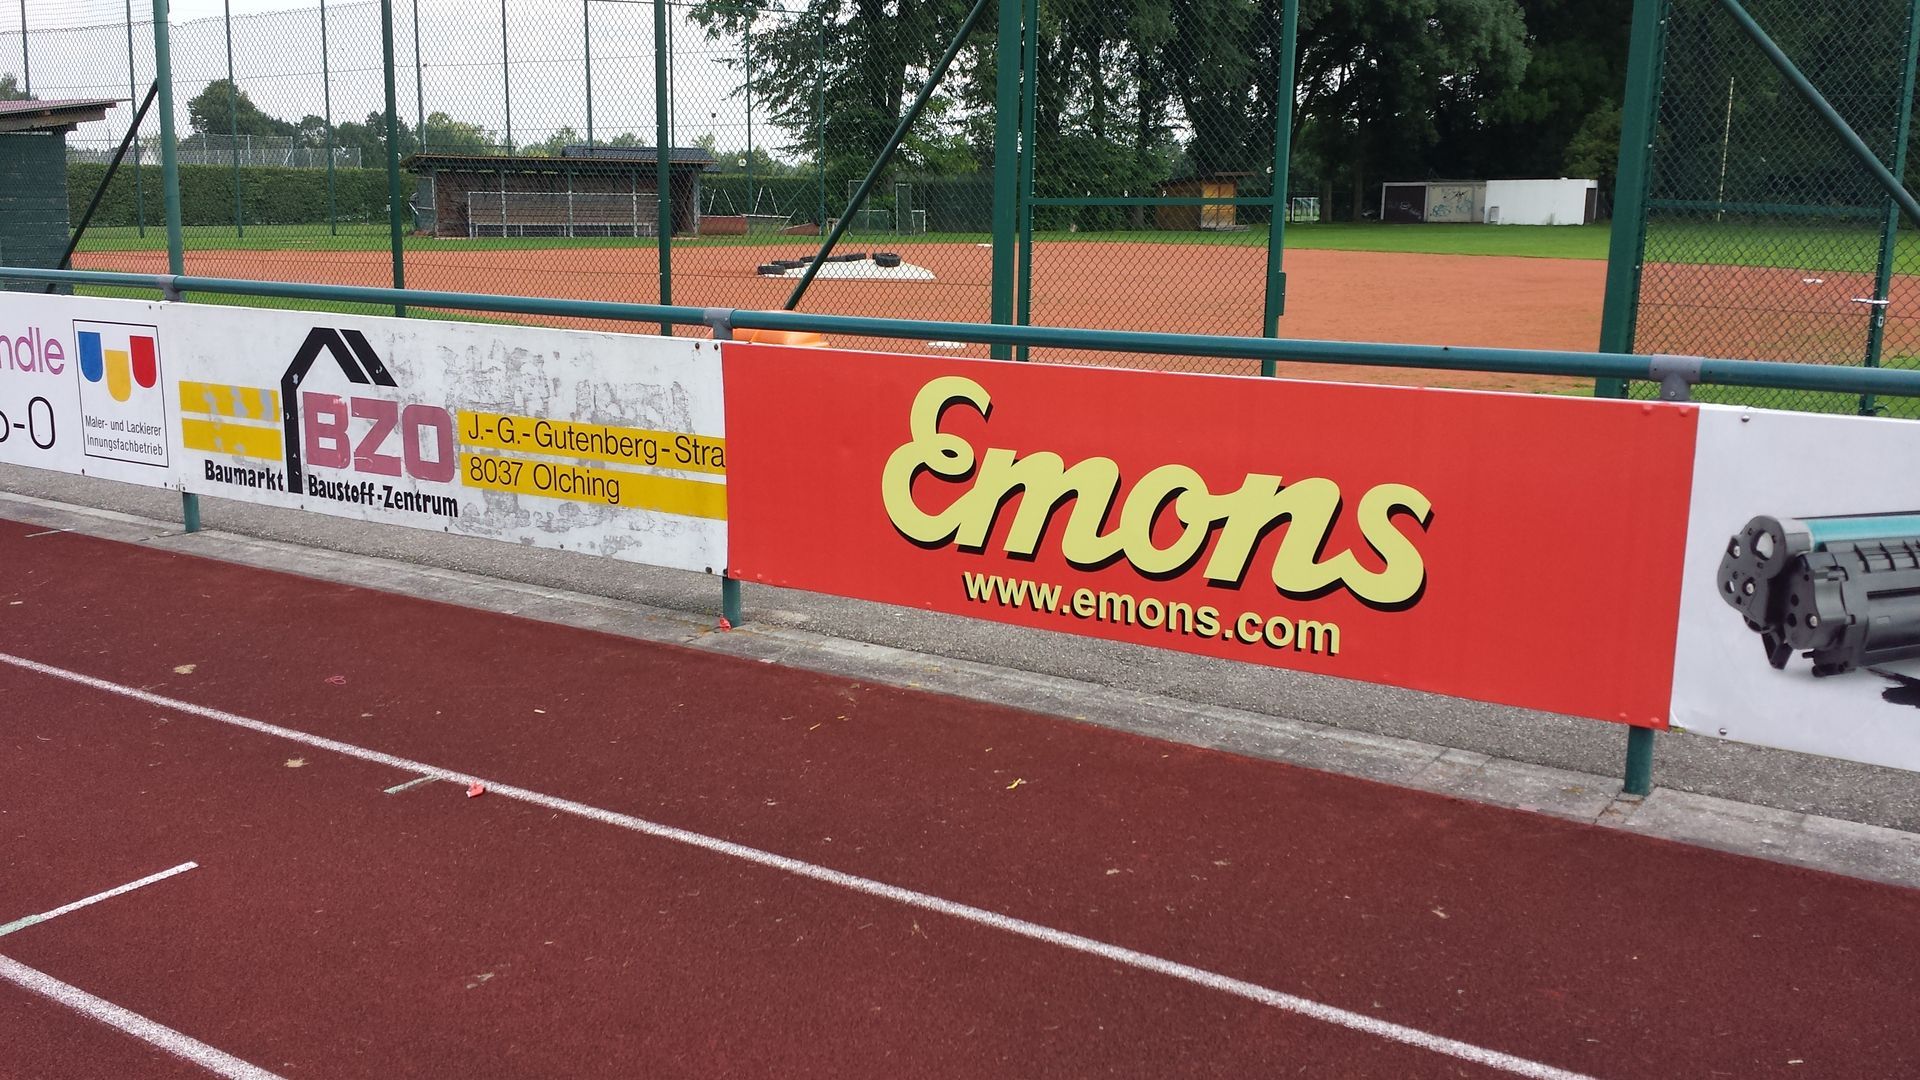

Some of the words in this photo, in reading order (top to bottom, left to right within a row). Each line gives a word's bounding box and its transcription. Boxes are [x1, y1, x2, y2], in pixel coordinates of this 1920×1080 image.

[85, 415, 108, 429] Maler-
[110, 420, 124, 432] und
[126, 420, 162, 436] Lackierer
[86, 434, 163, 456] Innungsfachbetrieb
[302, 391, 455, 483] BZO
[204, 459, 284, 492] Baumarkt
[308, 474, 459, 518] Baustoff-Zentrum
[469, 456, 524, 487] 8037
[533, 463, 620, 505] Olching
[881, 375, 1434, 611] Emons
[963, 571, 1342, 656] www.emons.com
